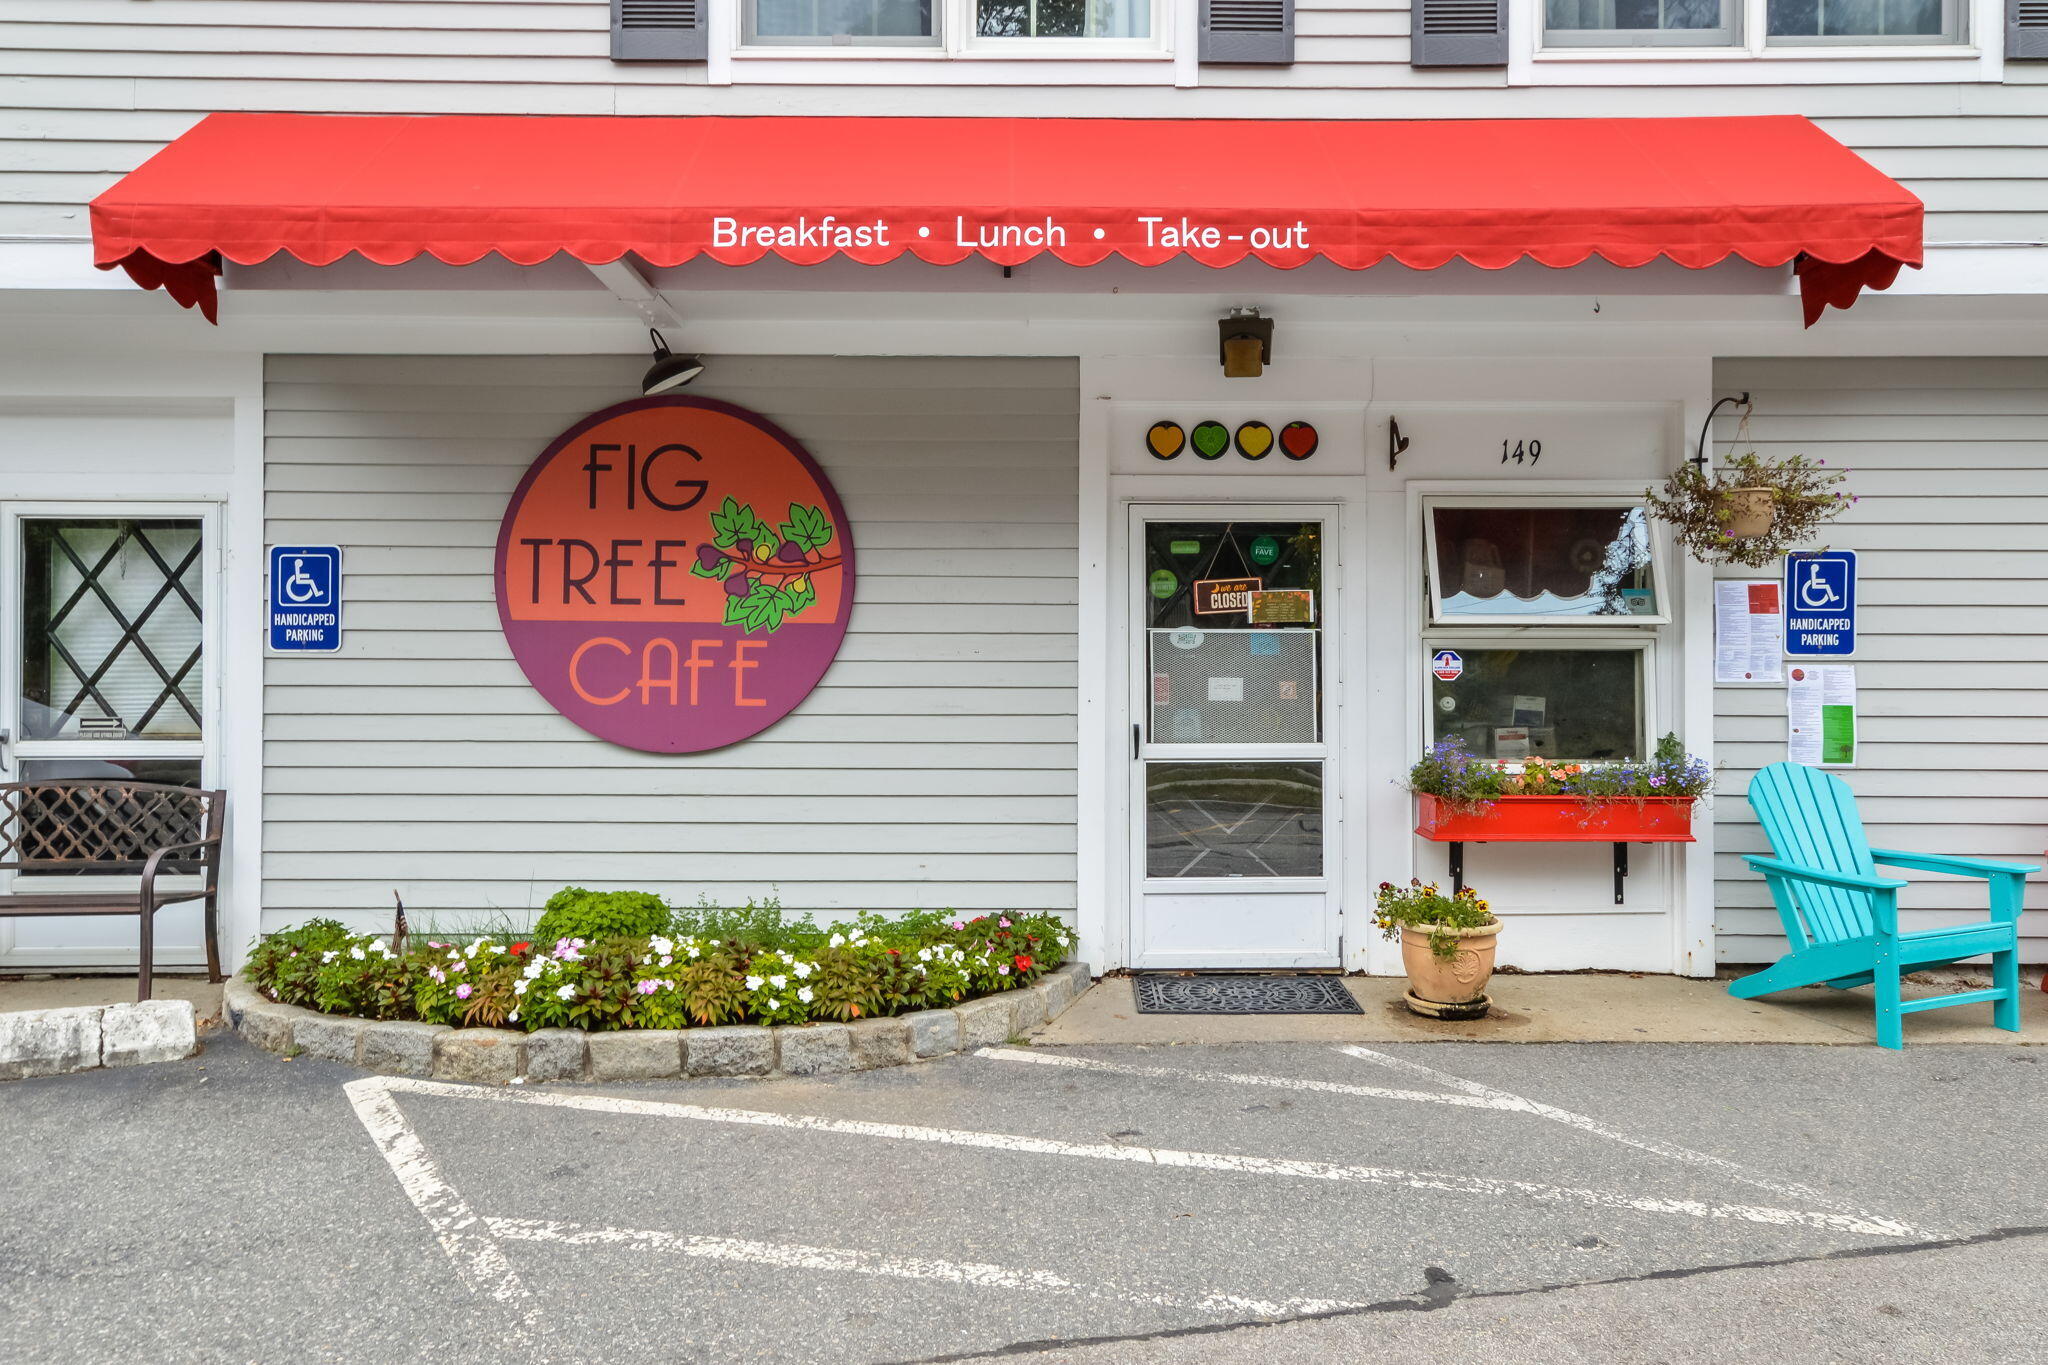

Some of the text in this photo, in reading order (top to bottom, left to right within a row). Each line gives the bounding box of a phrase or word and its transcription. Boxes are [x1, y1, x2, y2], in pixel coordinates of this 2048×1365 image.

[712, 215, 1310, 249] Breakfast Lunch Take-out
[1501, 439, 1541, 466] 149
[582, 443, 709, 512] FIG
[1255, 548, 1273, 556] FAVE
[520, 538, 687, 606] TREE
[1210, 592, 1248, 609] CLOSED
[274, 613, 336, 626] HANDICAPPED
[1789, 618, 1851, 630] HANDICAPPED
[285, 628, 324, 642] PARKING
[1801, 633, 1840, 646] PARKING
[568, 636, 768, 707] CAFE
